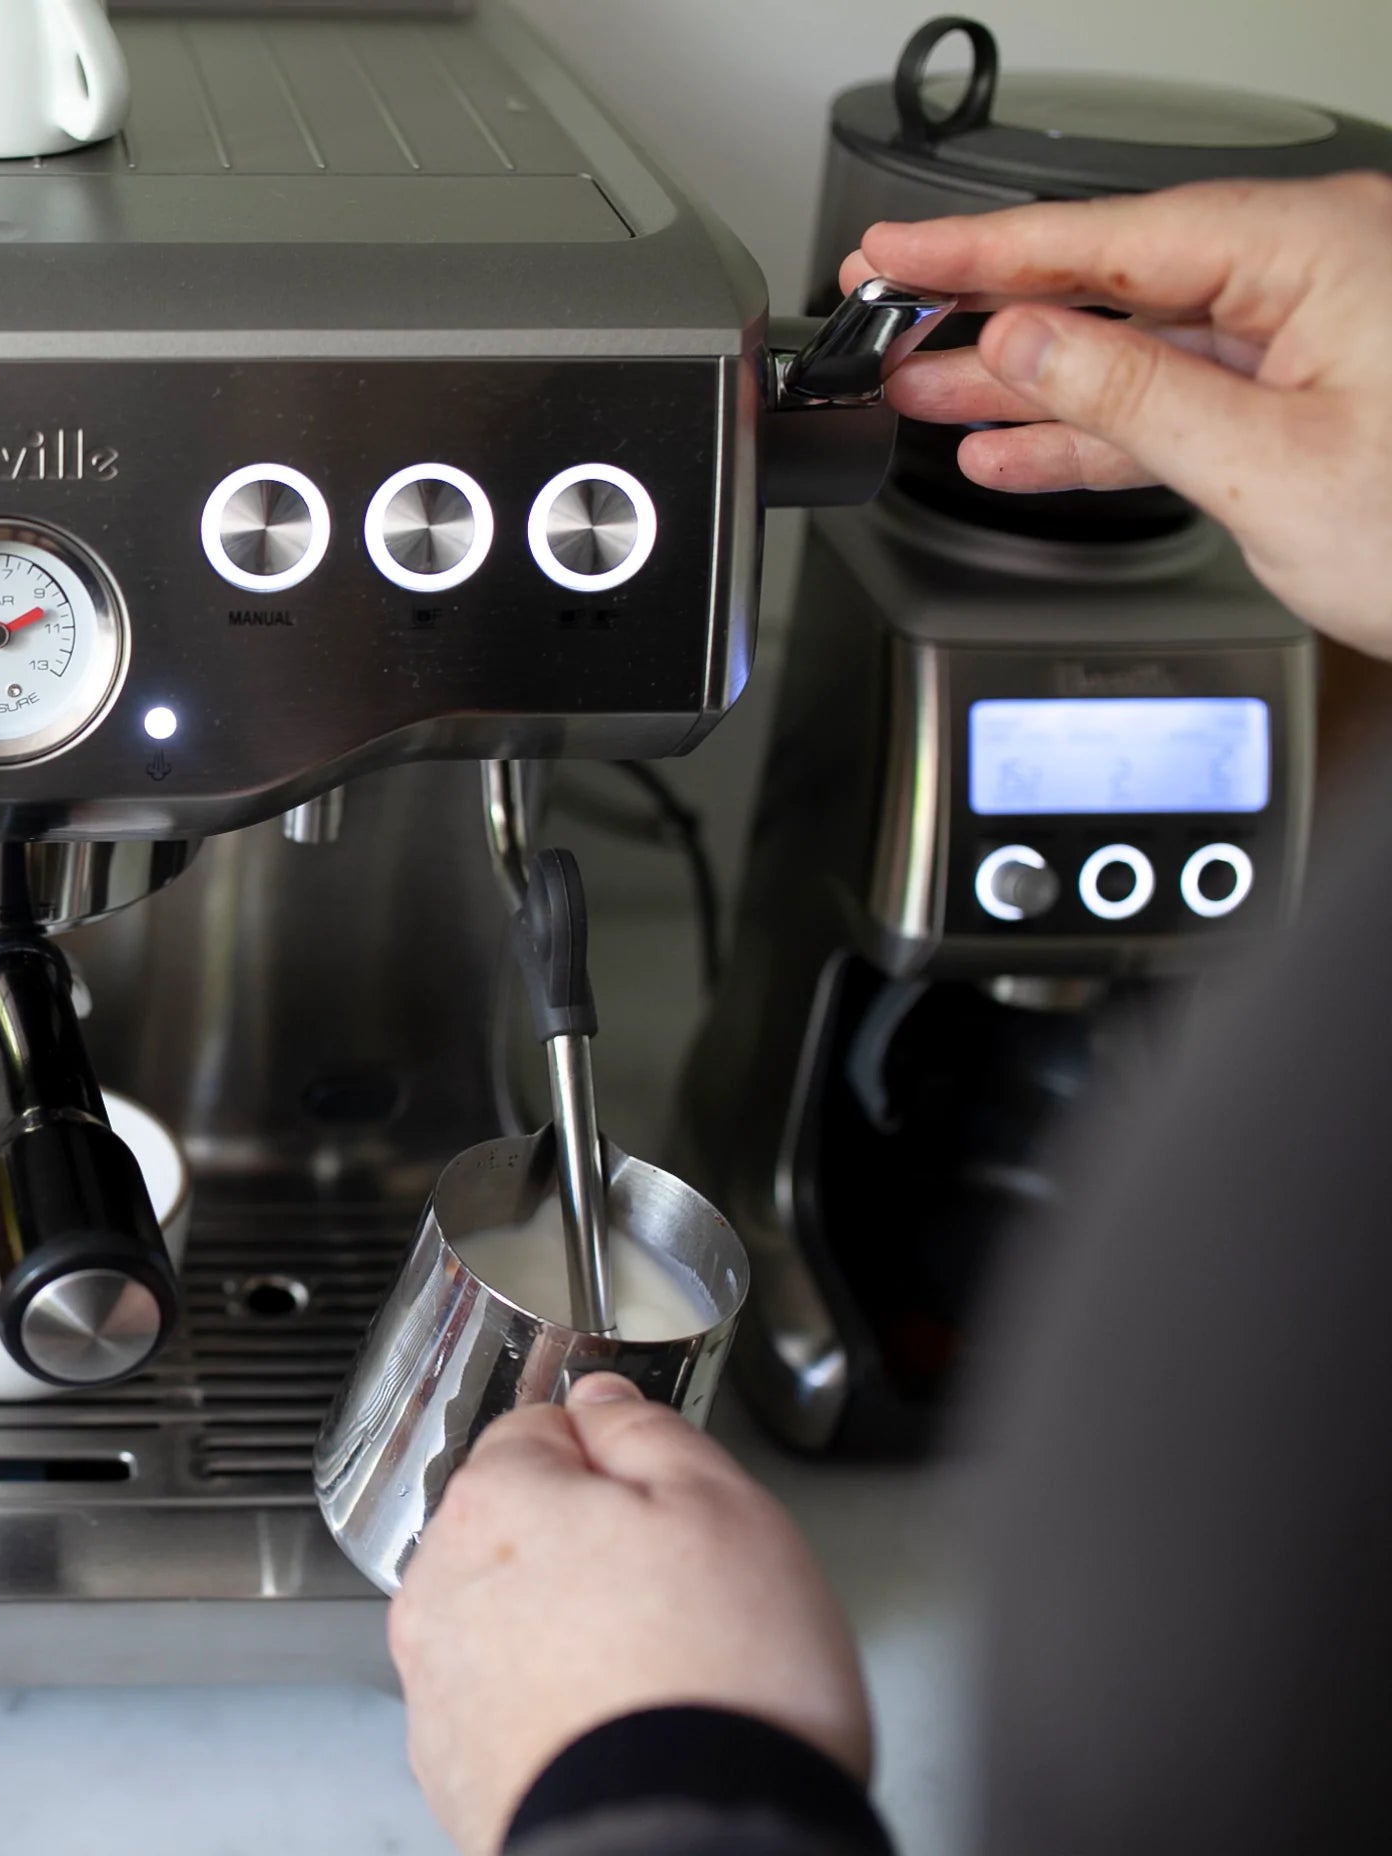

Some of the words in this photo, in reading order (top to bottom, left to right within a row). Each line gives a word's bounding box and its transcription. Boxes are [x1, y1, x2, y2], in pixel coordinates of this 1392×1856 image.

[2, 569, 15, 580] 7
[33, 587, 46, 599] 9
[228, 610, 294, 626] MANUAL
[45, 623, 61, 634] 11
[29, 660, 49, 671] 13
